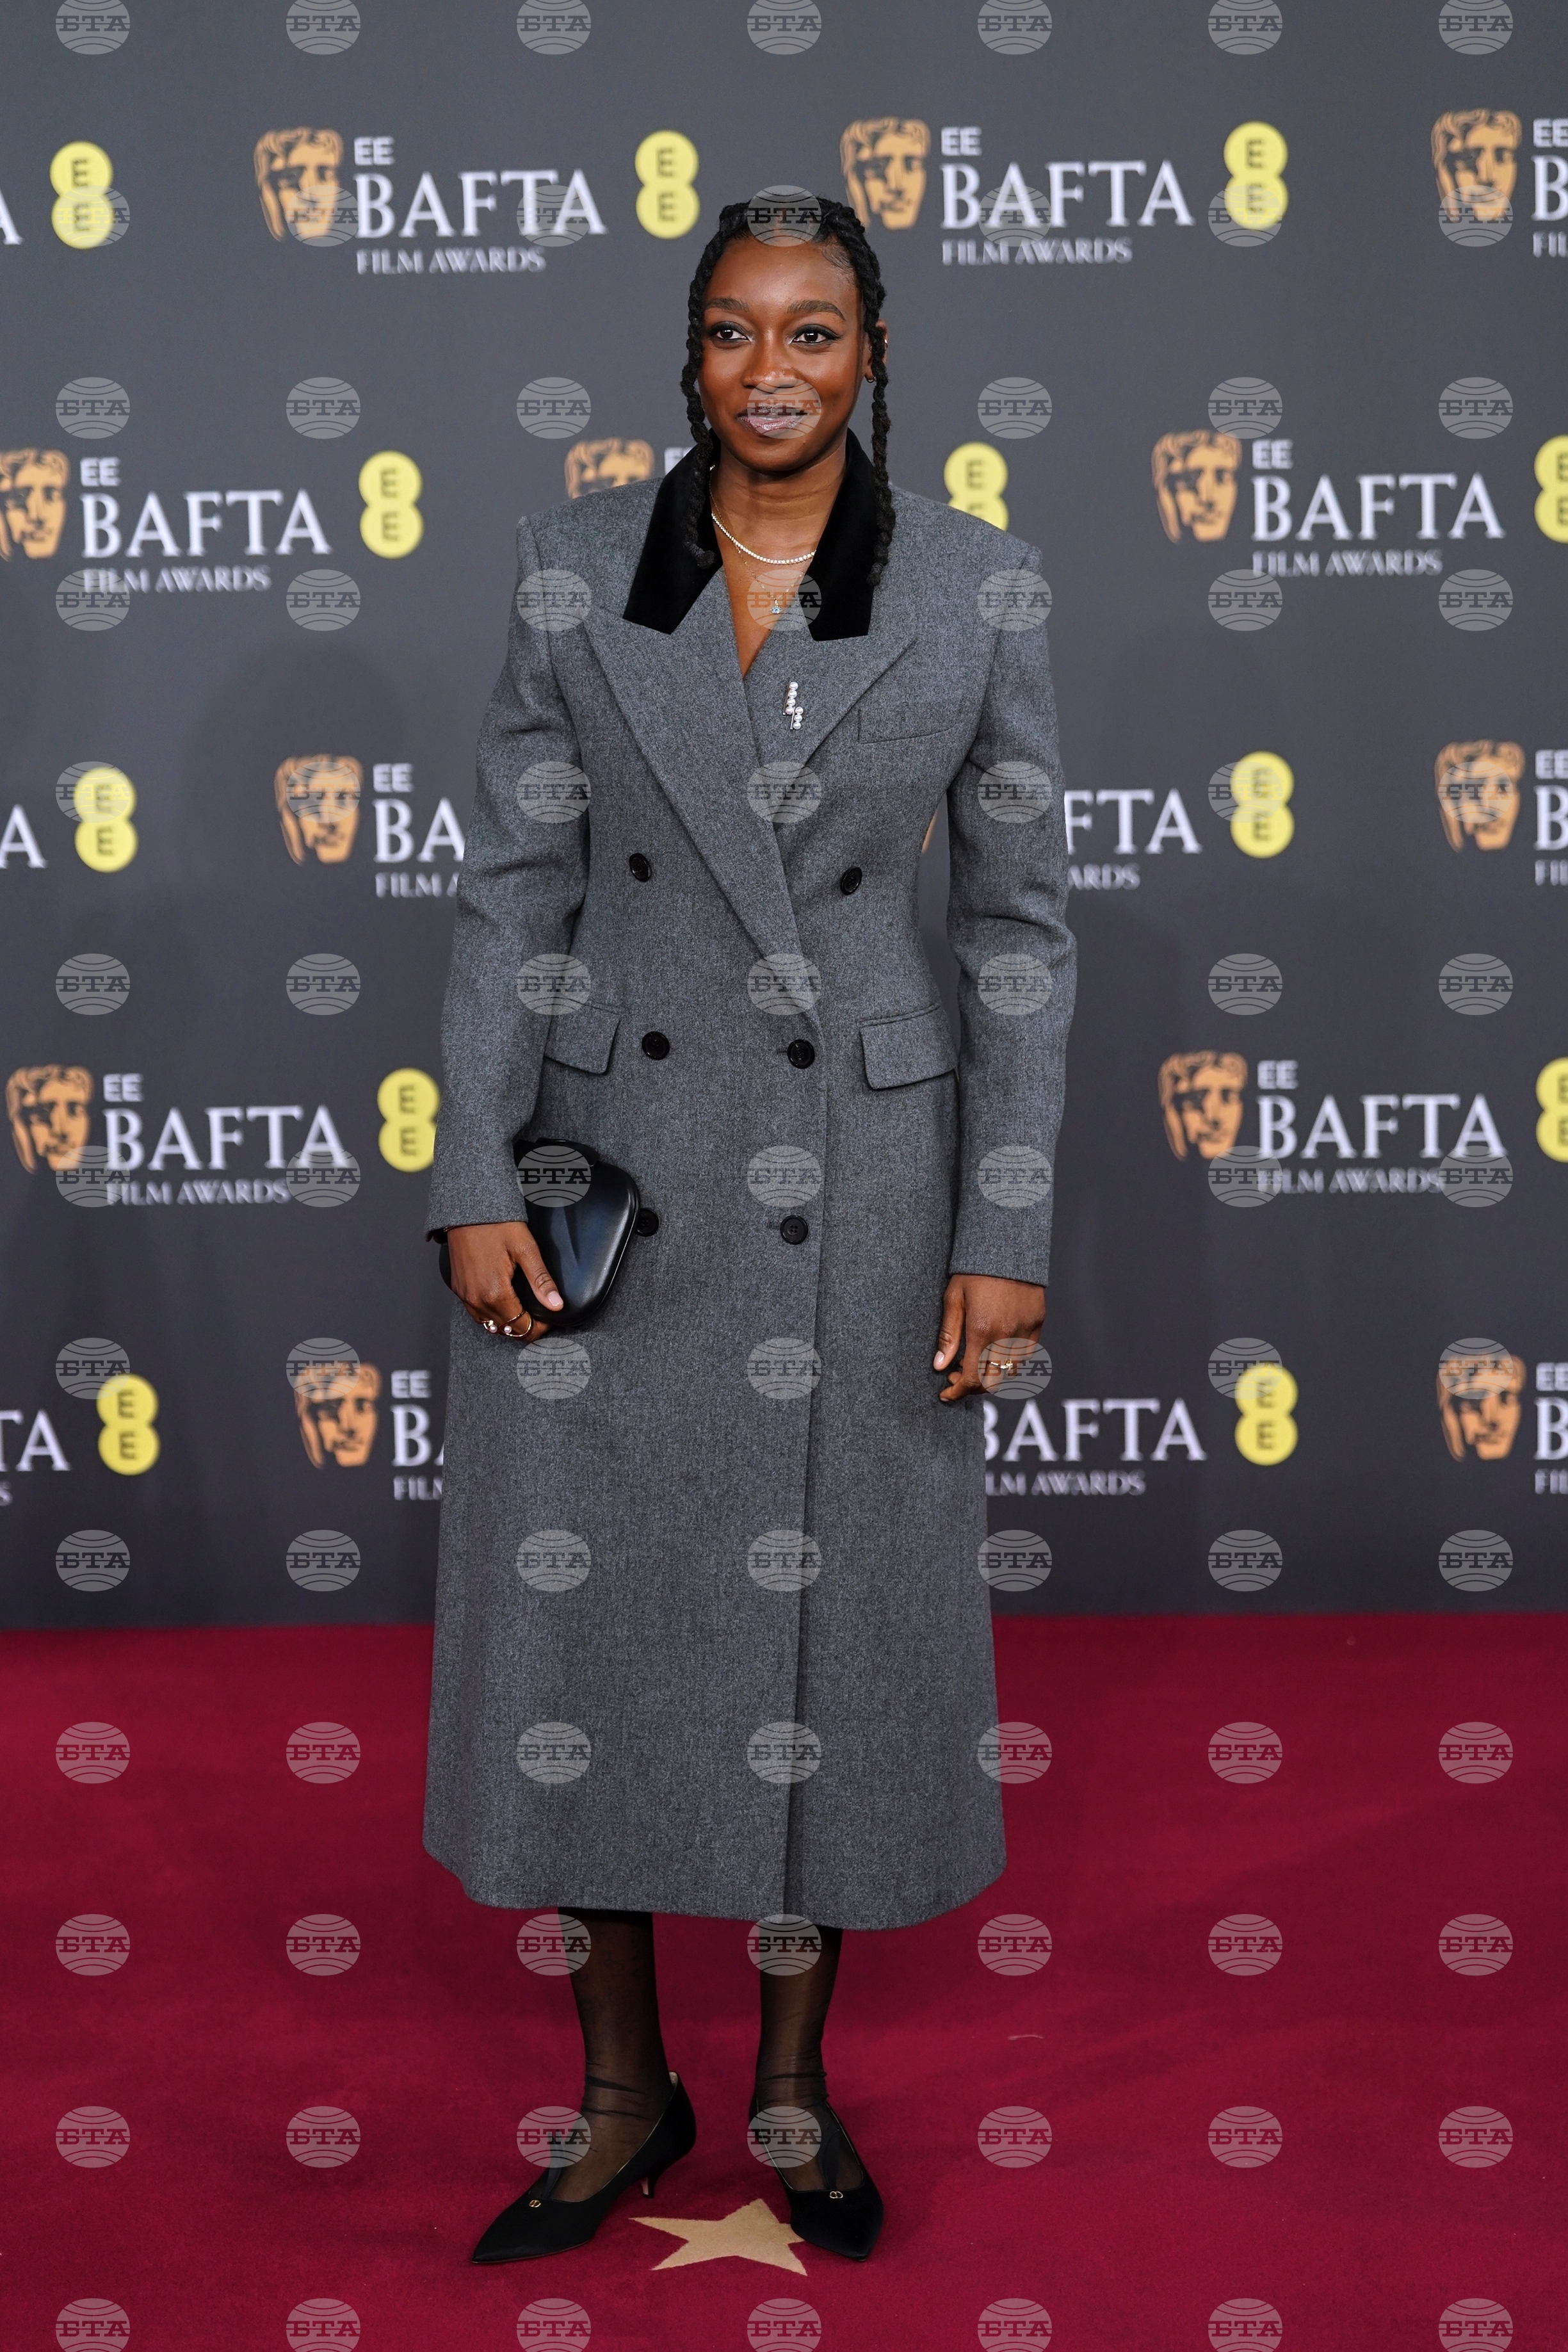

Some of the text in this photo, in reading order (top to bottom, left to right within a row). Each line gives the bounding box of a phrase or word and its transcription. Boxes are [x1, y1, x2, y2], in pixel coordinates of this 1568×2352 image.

[355, 138, 393, 165] EE
[941, 129, 981, 155] EE
[355, 171, 606, 238] BAFTA
[941, 162, 1193, 227] BAFTA
[358, 247, 546, 274] FILM AWARDS
[942, 238, 1133, 264] FILM AWARDS
[1252, 440, 1292, 469] EE
[80, 459, 120, 487] EE
[1252, 473, 1505, 541] BAFTA
[80, 490, 332, 558] BAFTA
[1252, 550, 1443, 578] FILM AWARDS
[83, 567, 270, 593] FILM AWARDS
[373, 764, 412, 792] EE
[1063, 788, 1202, 855] FTA
[376, 873, 442, 897] FILM
[1067, 863, 1140, 890] ARDS
[103, 1075, 143, 1103] EE
[1257, 1061, 1298, 1089] EE
[103, 1105, 353, 1171] BAFTA
[1256, 1094, 1507, 1159] BAFTA
[107, 1179, 289, 1206] FILM AWARDS
[1258, 1168, 1444, 1195] FILM AWARDS
[392, 1371, 431, 1398] EE
[1031, 1470, 1147, 1496] AWARDS
